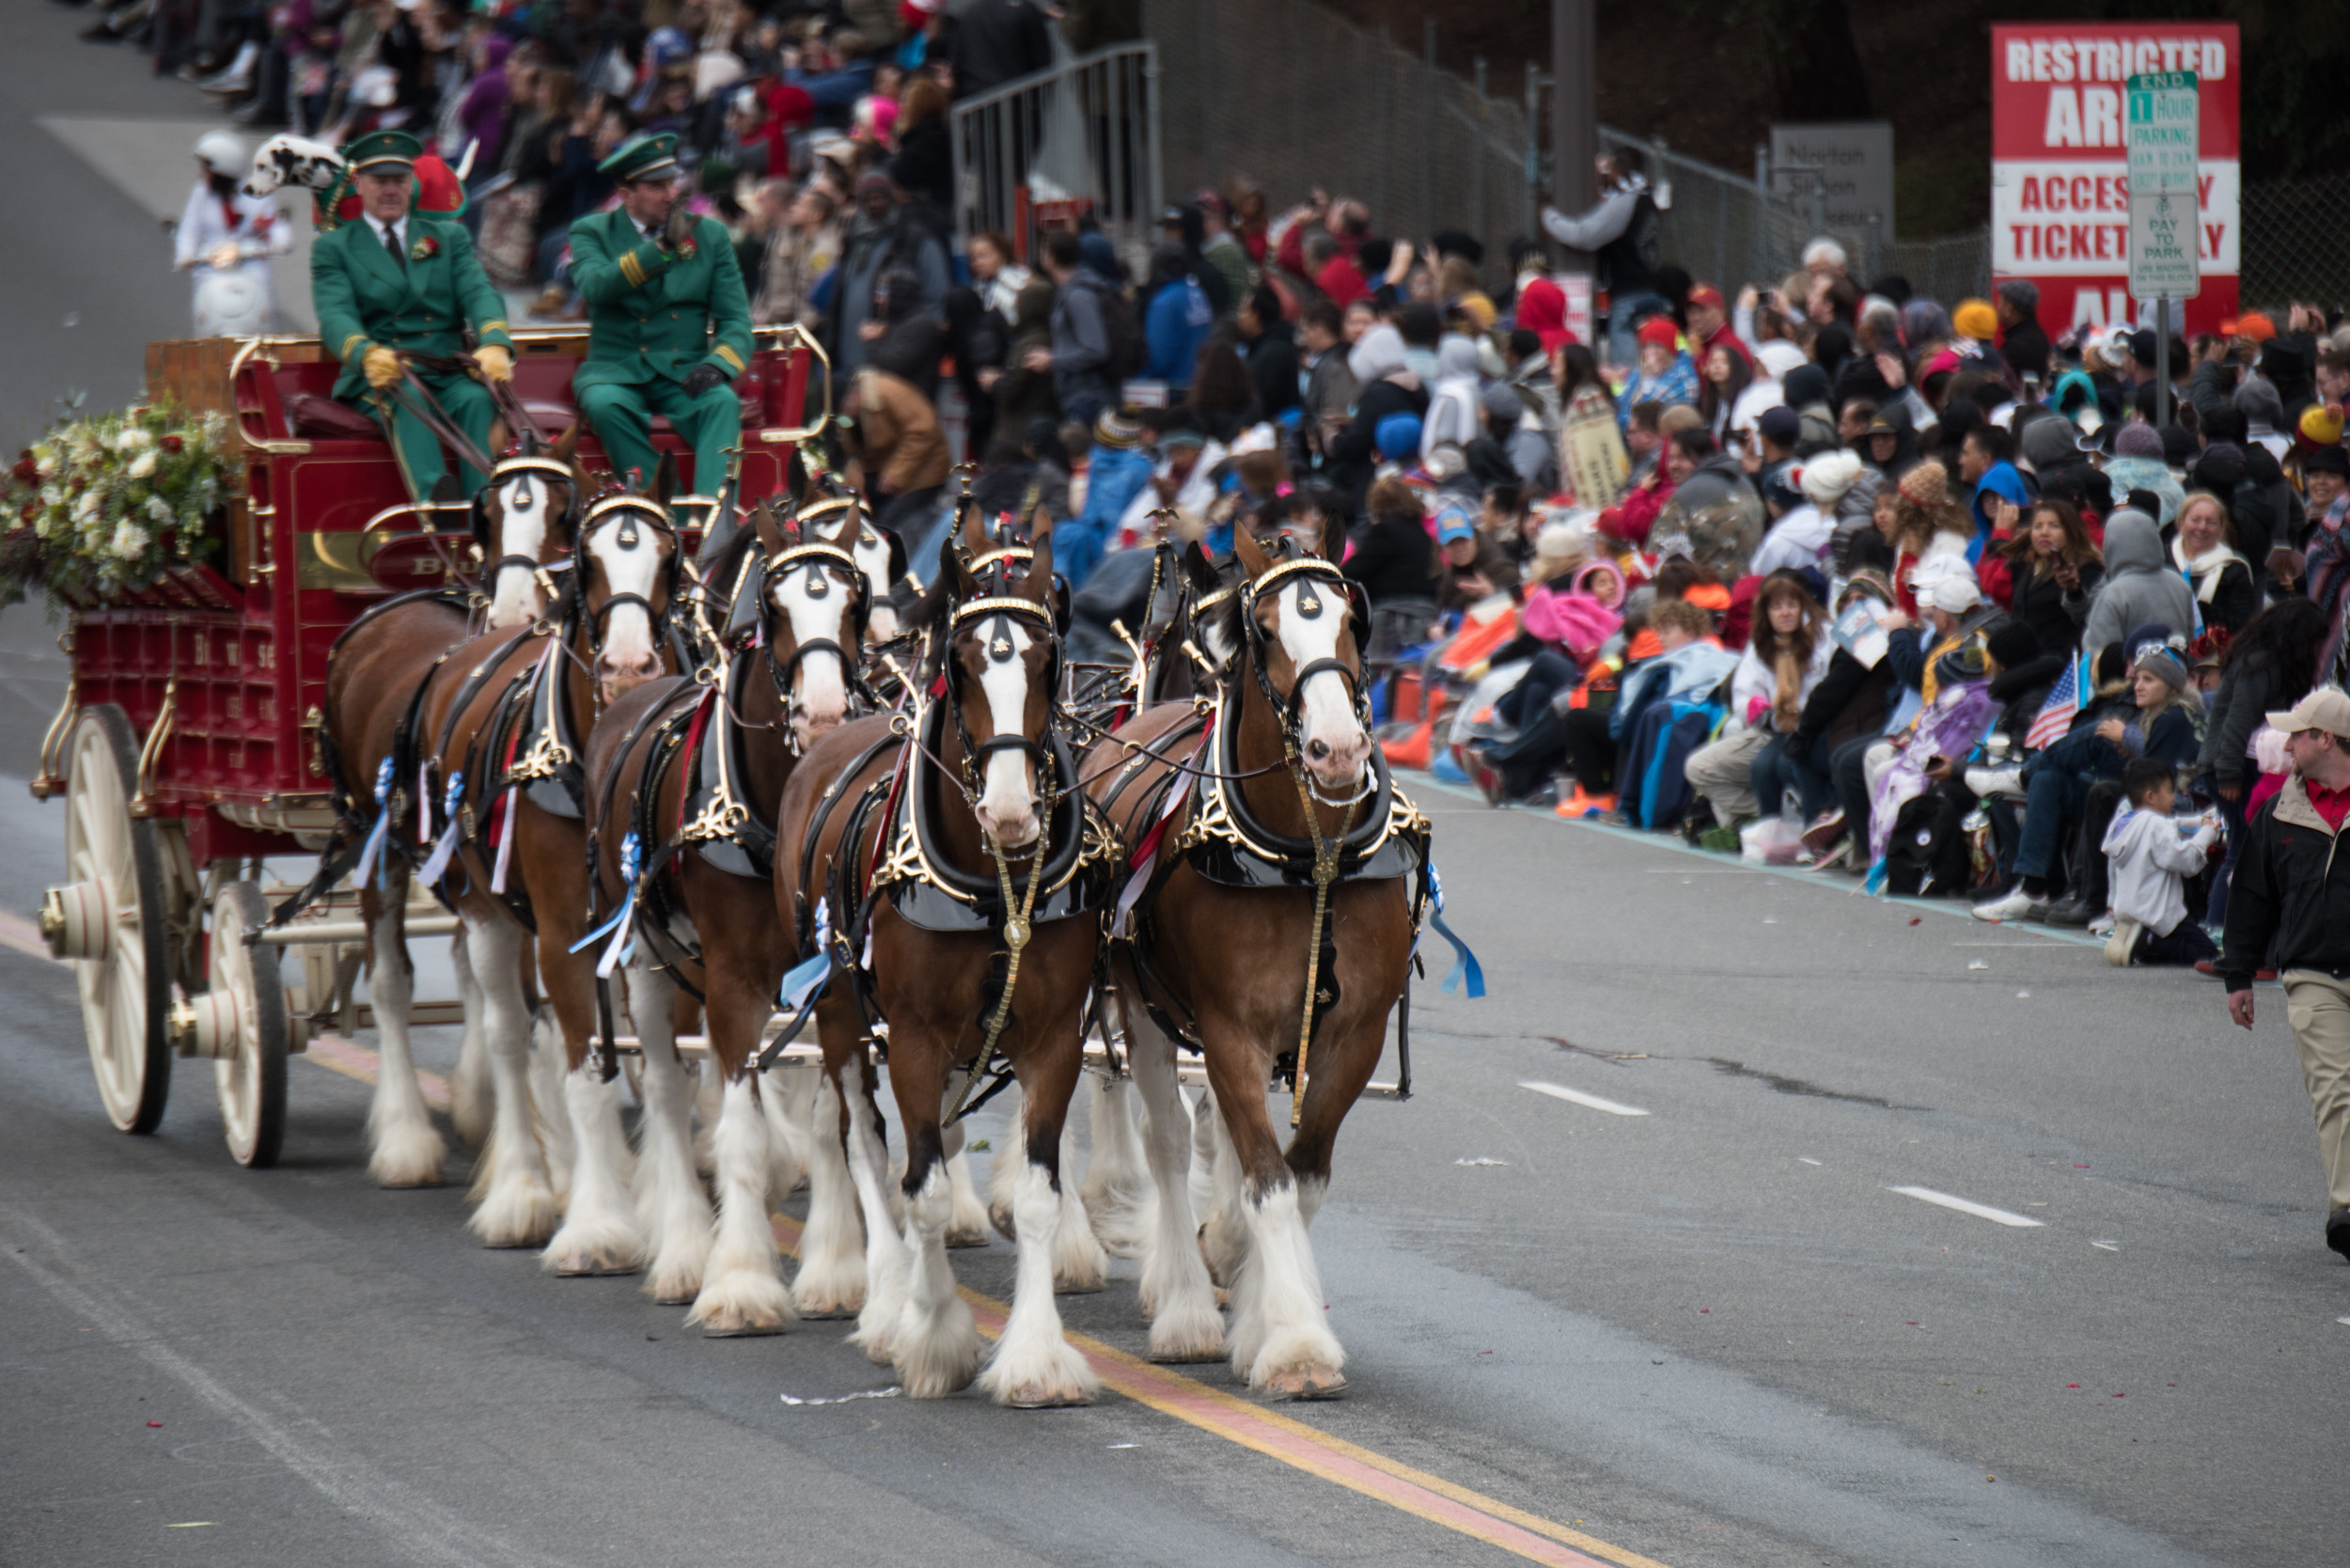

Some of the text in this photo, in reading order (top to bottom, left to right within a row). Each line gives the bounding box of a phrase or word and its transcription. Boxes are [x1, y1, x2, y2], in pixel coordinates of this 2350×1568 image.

[2005, 39, 2227, 82] RESTRICTED
[2140, 74, 2185, 89] END
[2044, 86, 2128, 148] AR
[2156, 98, 2194, 120] HOUR
[2135, 128, 2192, 147] PARKING
[2021, 176, 2128, 213] ACCES
[2149, 219, 2178, 231] PAY
[2154, 233, 2174, 245] TO
[2144, 248, 2184, 259] PARK
[2136, 274, 2146, 282] ON
[2149, 274, 2165, 282] THIS
